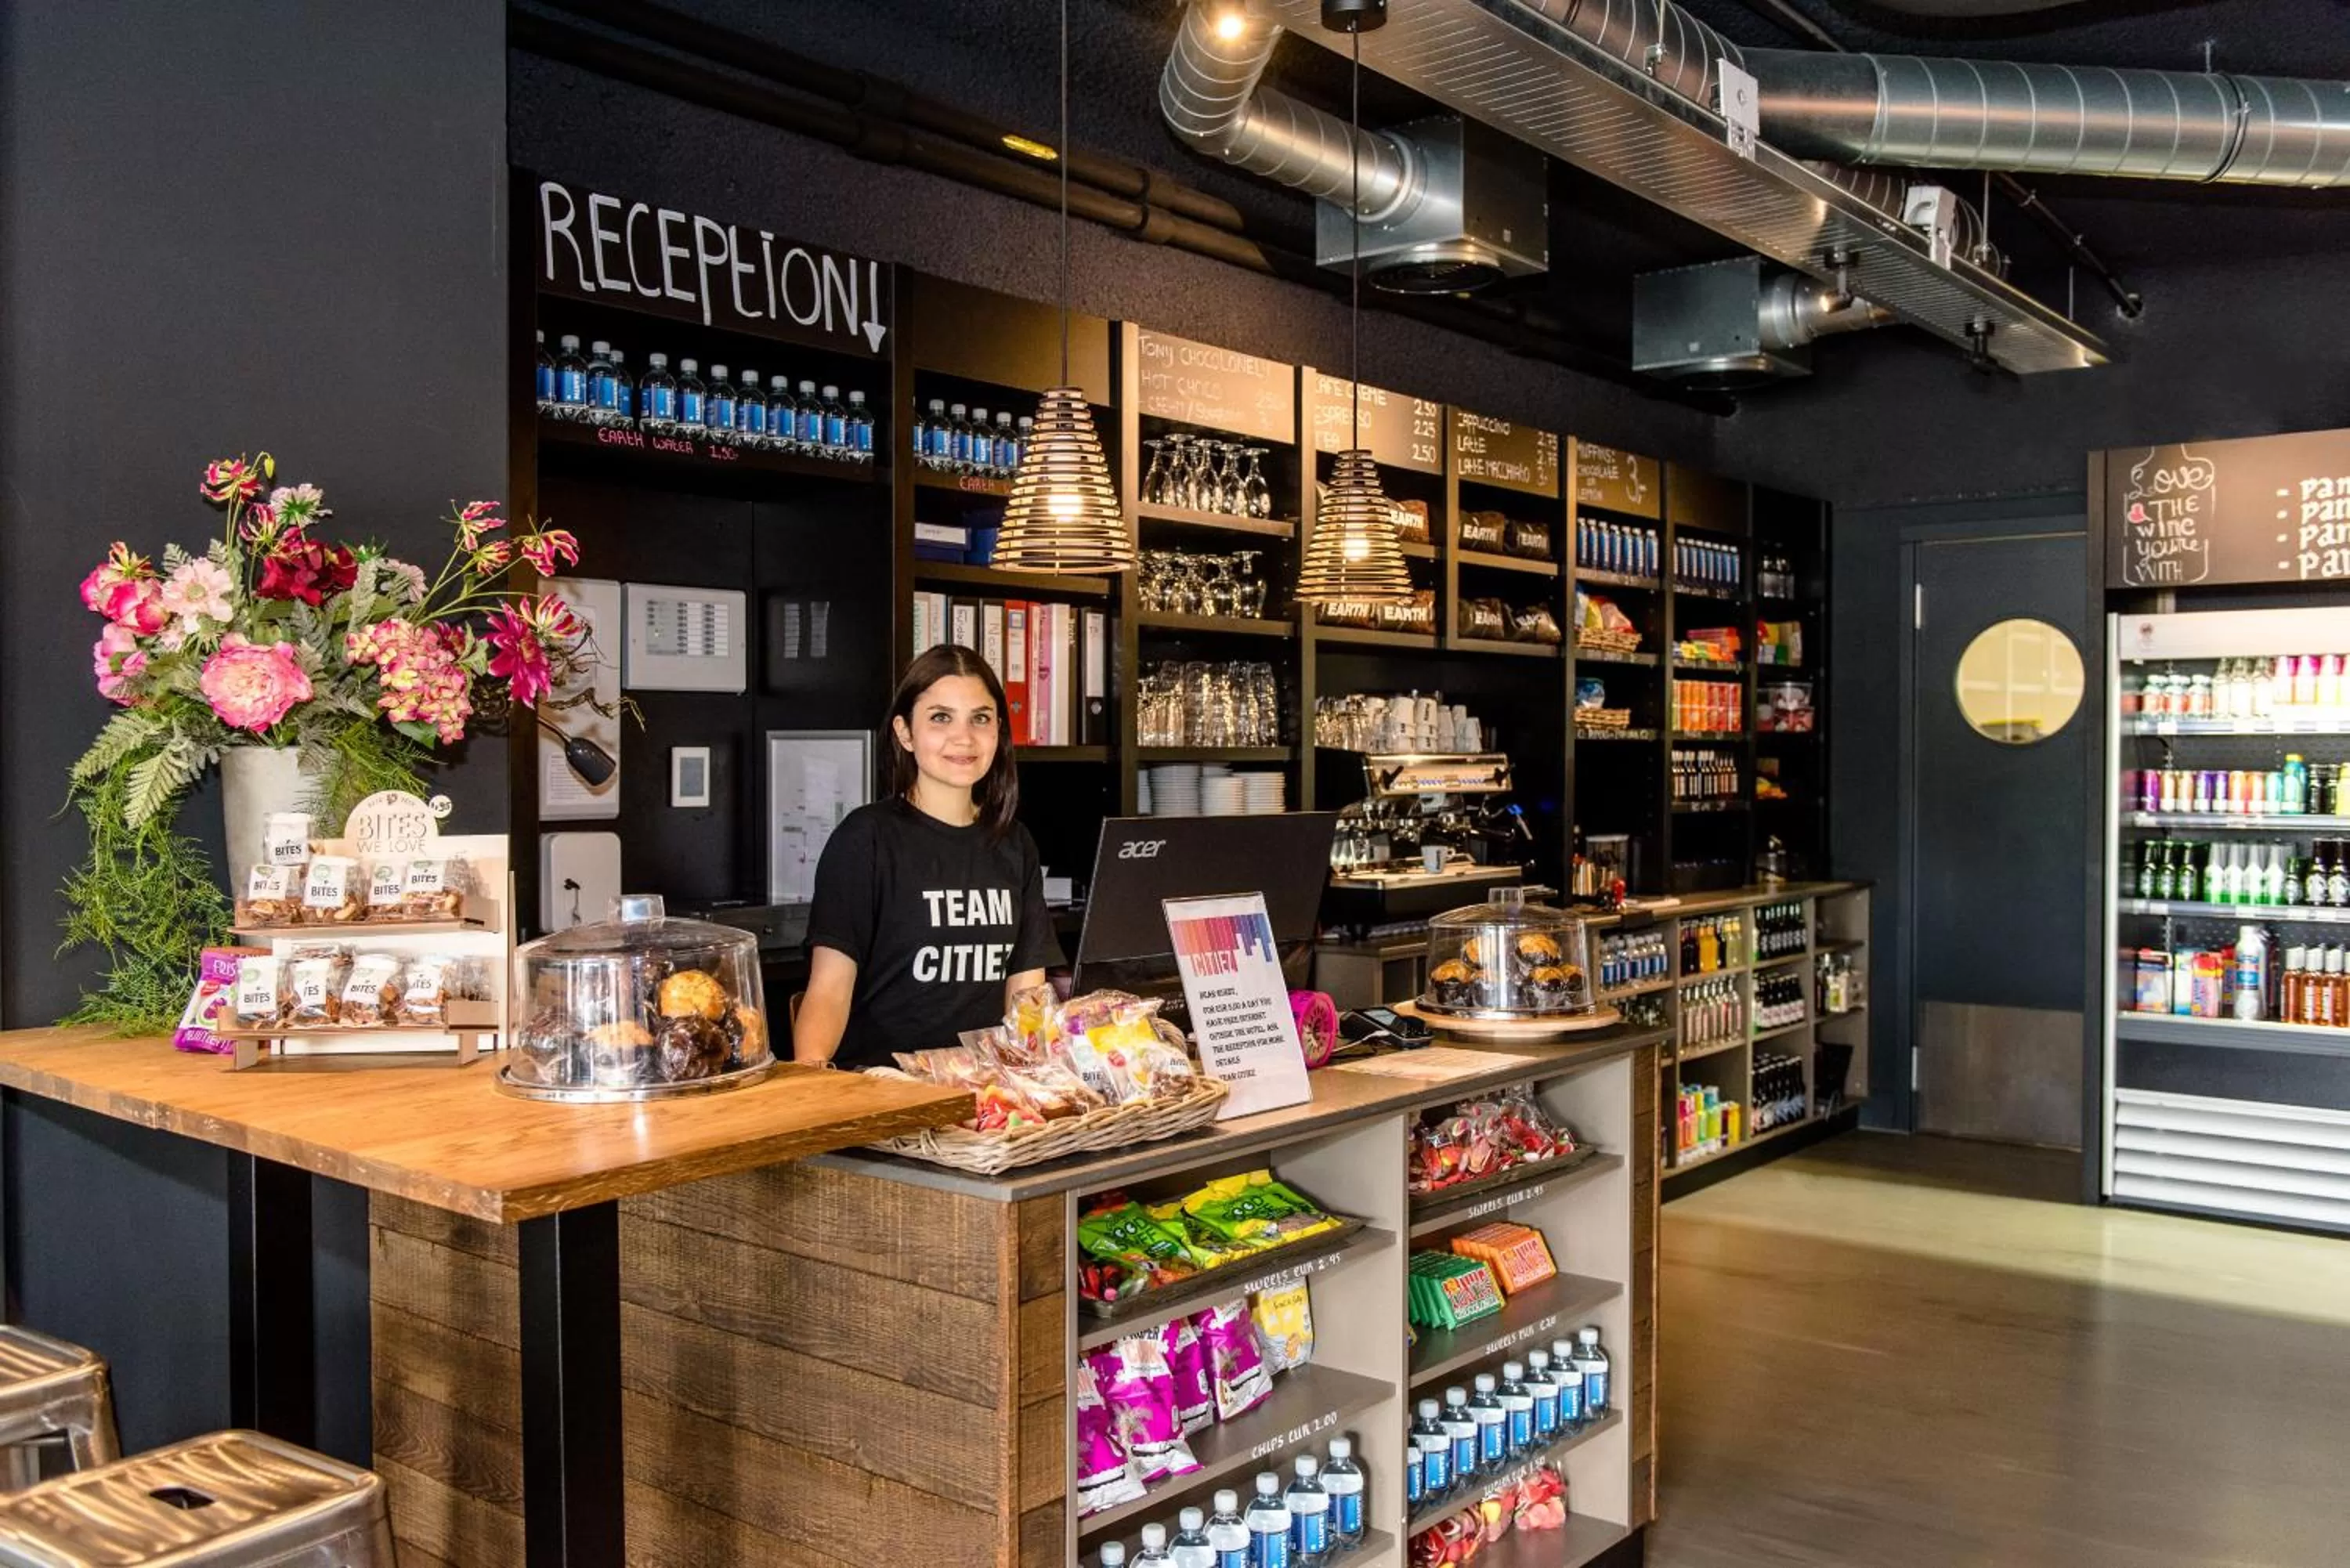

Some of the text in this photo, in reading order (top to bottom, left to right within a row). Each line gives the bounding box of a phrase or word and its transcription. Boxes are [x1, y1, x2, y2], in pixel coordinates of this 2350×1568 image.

[1383, 605, 1428, 622] EARTH
[356, 812, 428, 840] BITES
[275, 845, 302, 856] BITES
[356, 840, 382, 854] WE
[1118, 839, 1166, 859] acer
[411, 874, 438, 884] BITES
[311, 886, 338, 898] BITES
[374, 884, 401, 895] BITES
[922, 888, 1013, 927] TEAM
[244, 992, 270, 1004] BITES
[1251, 1434, 1285, 1459] CHIPS
[1288, 1423, 1311, 1443] EUR
